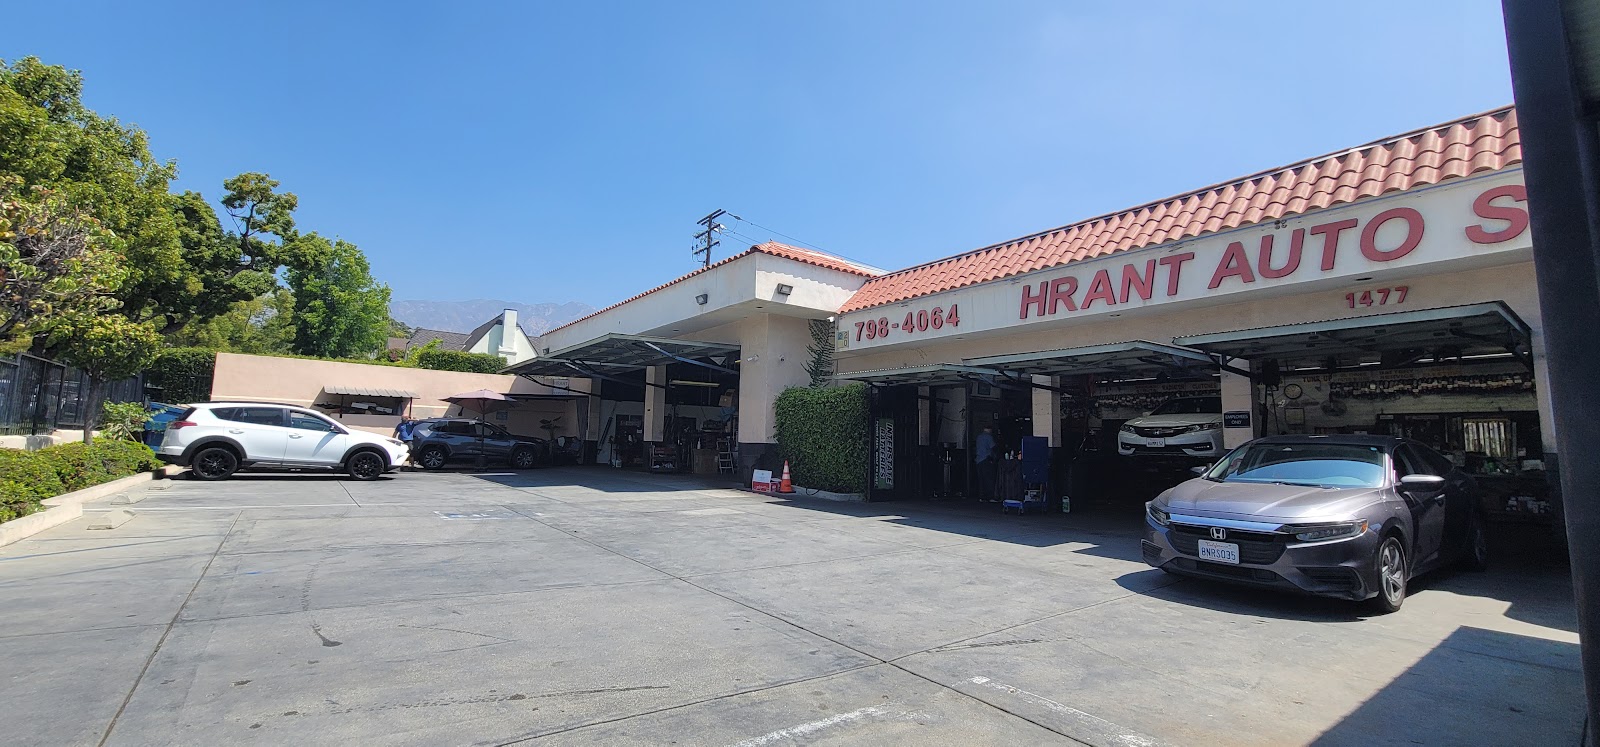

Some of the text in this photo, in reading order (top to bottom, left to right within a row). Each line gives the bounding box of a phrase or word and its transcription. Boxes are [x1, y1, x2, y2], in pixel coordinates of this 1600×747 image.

[1020, 252, 1195, 319] HRANT
[1207, 207, 1425, 289] AUTO
[855, 303, 960, 341] 798-4064
[1346, 286, 1409, 309] 1477
[885, 422, 894, 485] INTERSTATE
